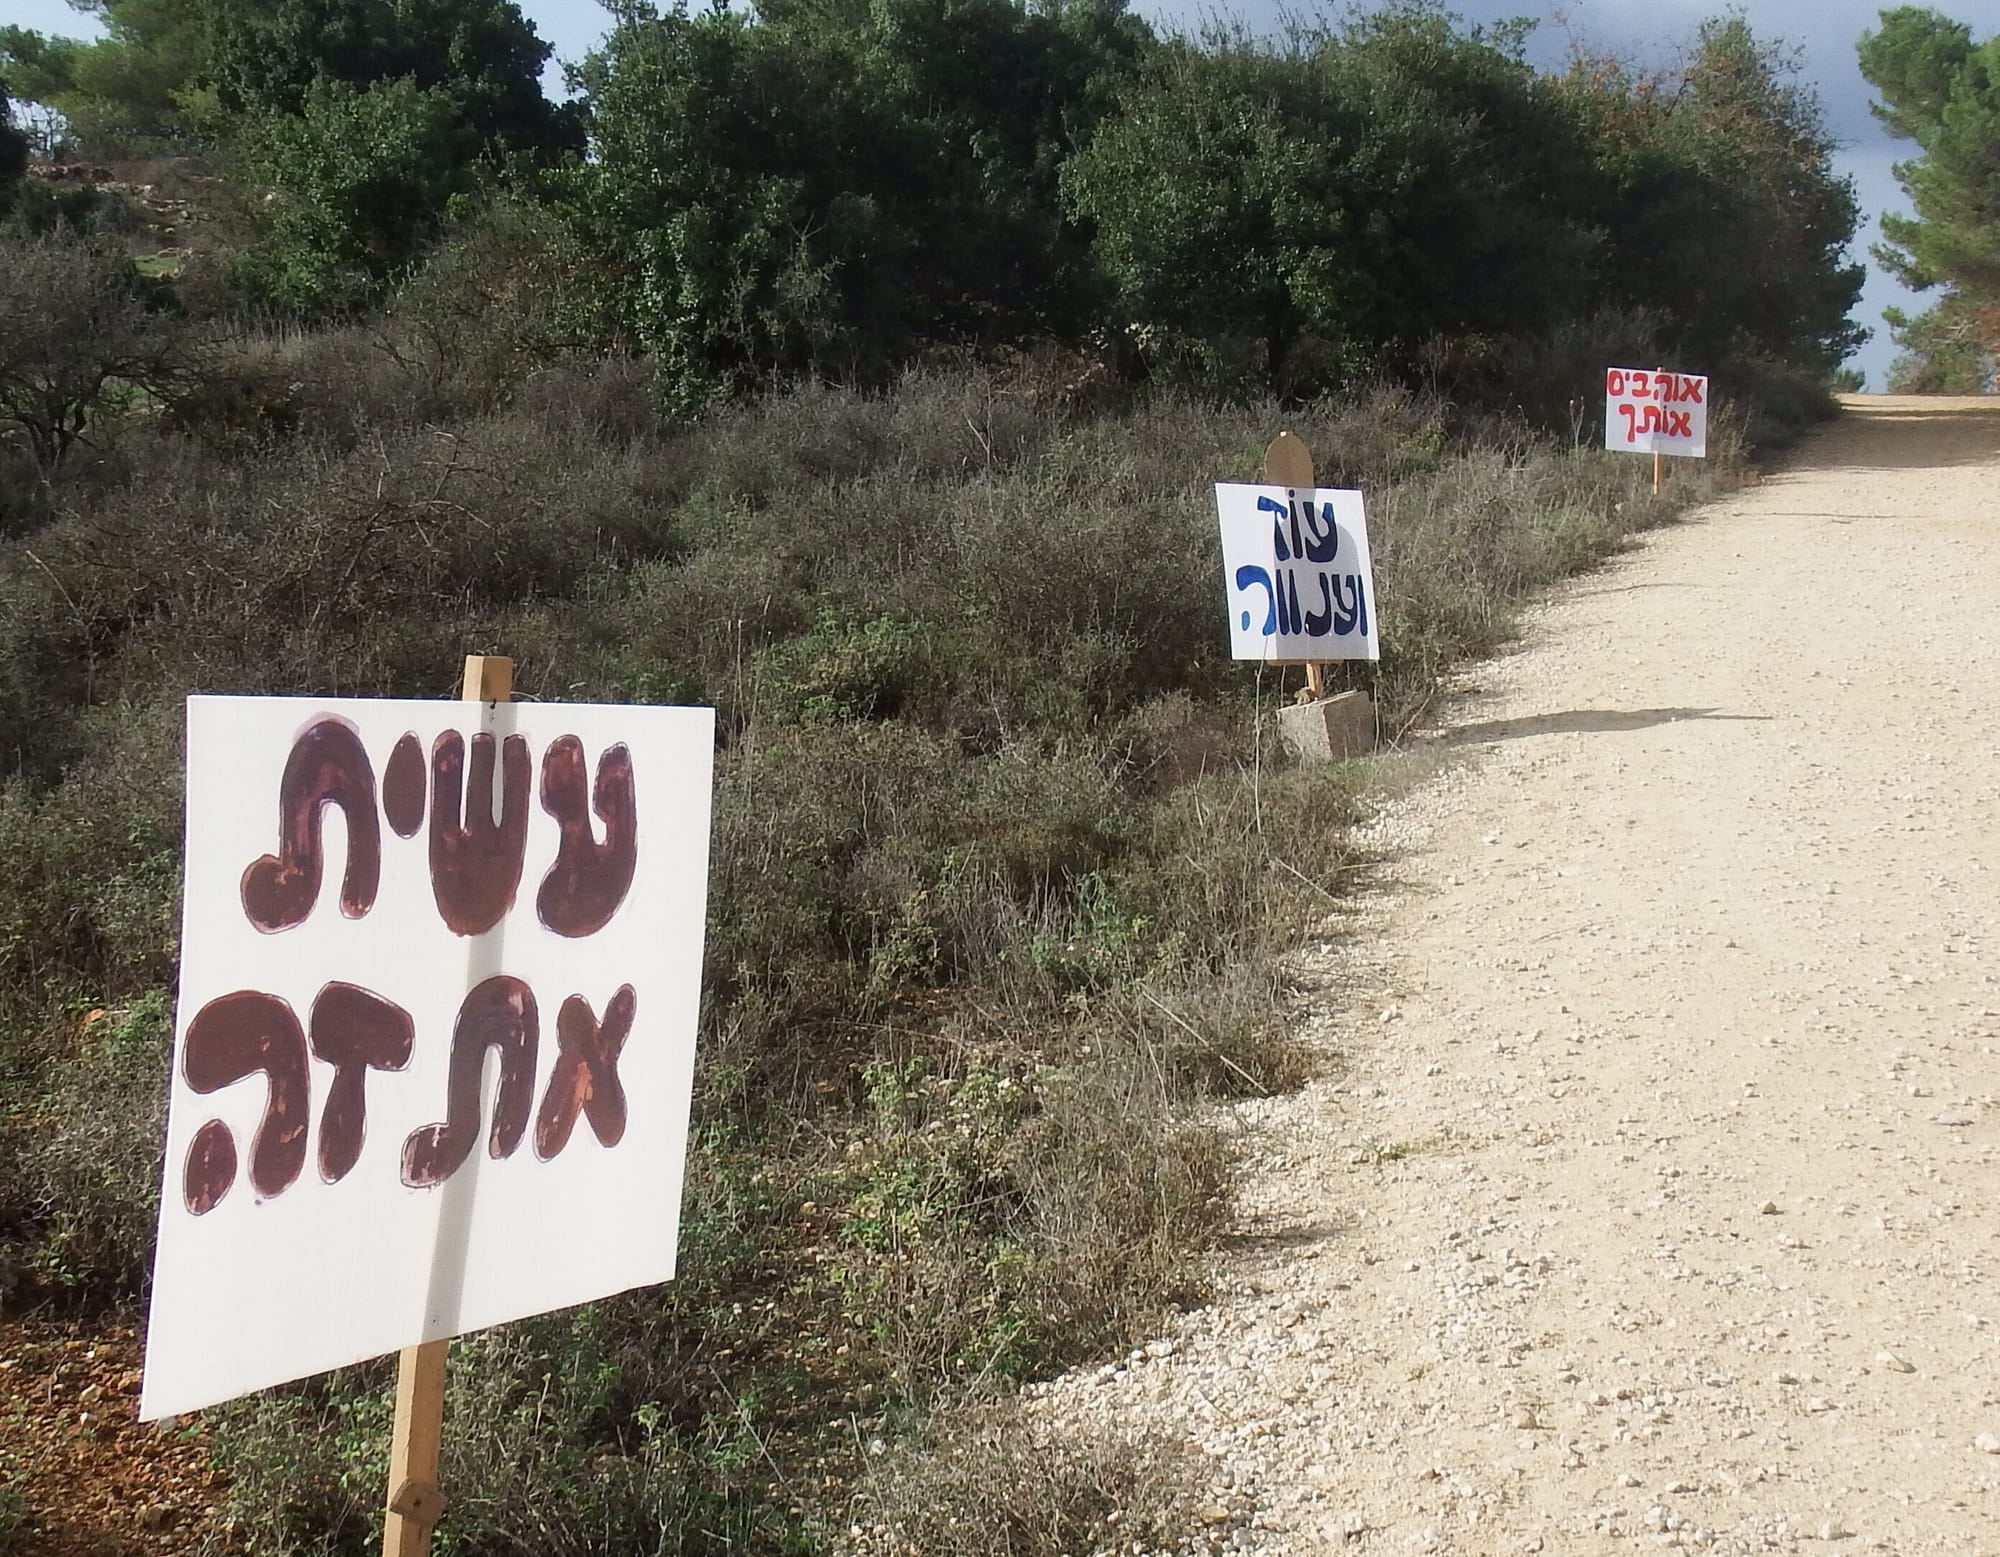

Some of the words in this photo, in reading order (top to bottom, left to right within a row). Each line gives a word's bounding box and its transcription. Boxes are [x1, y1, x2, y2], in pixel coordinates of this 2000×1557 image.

[1608, 370, 1703, 403] אוהבים
[1236, 564, 1368, 637] וענווה
[240, 713, 638, 938] עשית
[182, 980, 415, 1216] זה
[401, 974, 636, 1188] את
